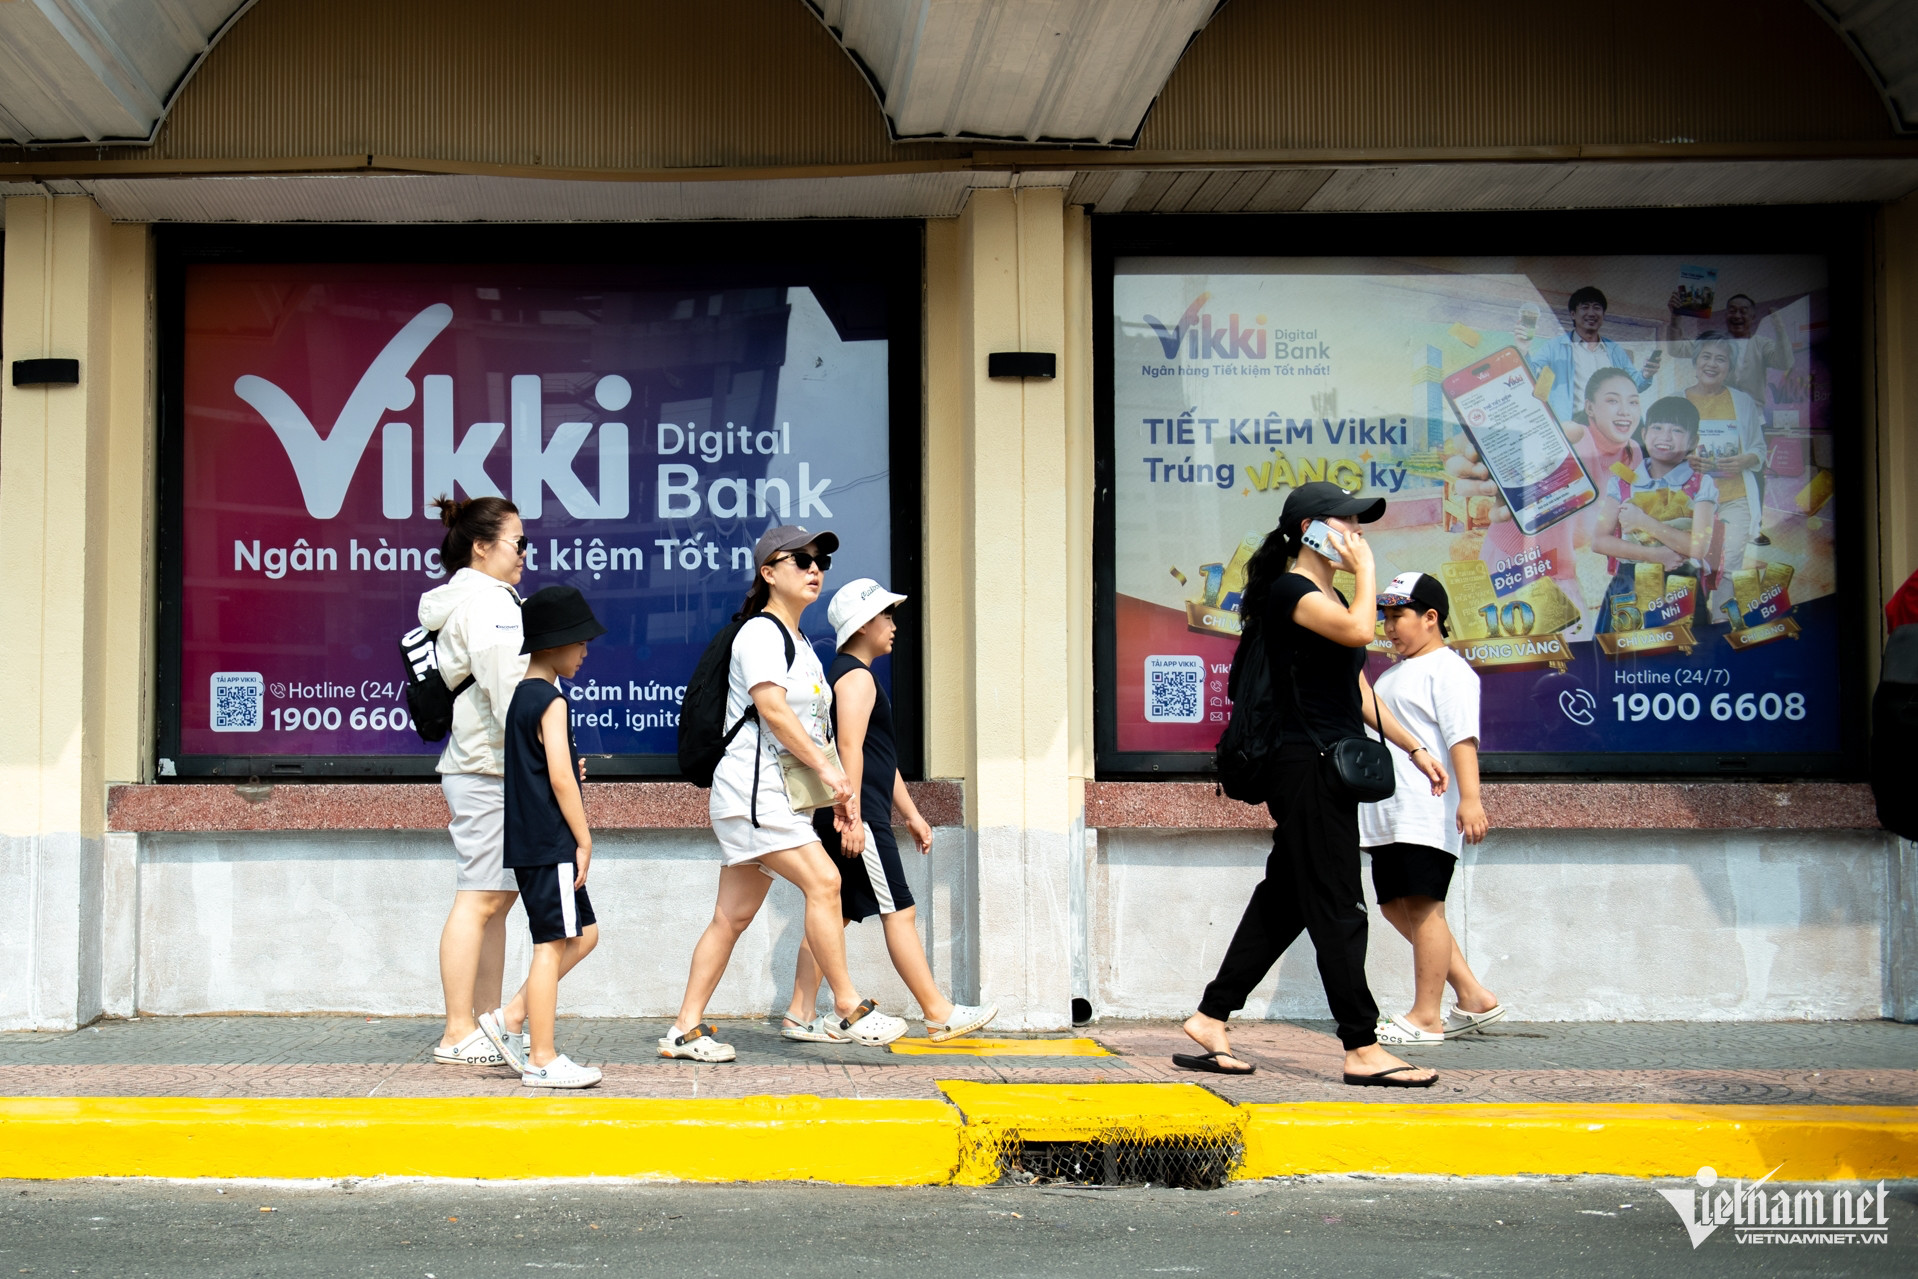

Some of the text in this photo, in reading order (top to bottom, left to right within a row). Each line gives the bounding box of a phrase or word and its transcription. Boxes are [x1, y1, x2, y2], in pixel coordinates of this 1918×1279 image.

[1143, 291, 1267, 359] Vikki
[1275, 329, 1317, 342] Digital
[1275, 341, 1330, 359] Bank
[1142, 363, 1330, 379] Ngân hàng Tiết kiệm Tốt nhất!
[234, 303, 632, 519] Vikki
[657, 421, 790, 463] Digital
[1142, 406, 1407, 453] TIẾT KIỆM Vikki
[1142, 450, 1407, 494] Trúng VÀNG ký
[657, 462, 834, 519] Bank
[233, 538, 446, 580] Ngân hàng
[550, 537, 644, 580] kiệm
[654, 532, 720, 570] Tốt
[1496, 545, 1542, 573] 01 Giải
[1494, 572, 1522, 590] Đặc
[1523, 559, 1552, 579] Biệt
[1610, 591, 1644, 631] 5
[1648, 586, 1689, 612] 05 Giải
[1747, 599, 1760, 613] 10
[1761, 604, 1777, 618] Ba
[1478, 600, 1535, 638] 10
[1720, 597, 1745, 632] 1
[1456, 640, 1560, 663] ƯỢNG VÀNG
[289, 680, 411, 702] Hotline (24/
[570, 679, 688, 705] cảm hứng
[1615, 669, 1730, 688] Hotline (24/7)
[270, 707, 417, 731] 1900 660
[1612, 692, 1807, 721] 1900 6608
[466, 1054, 503, 1064] crocs
